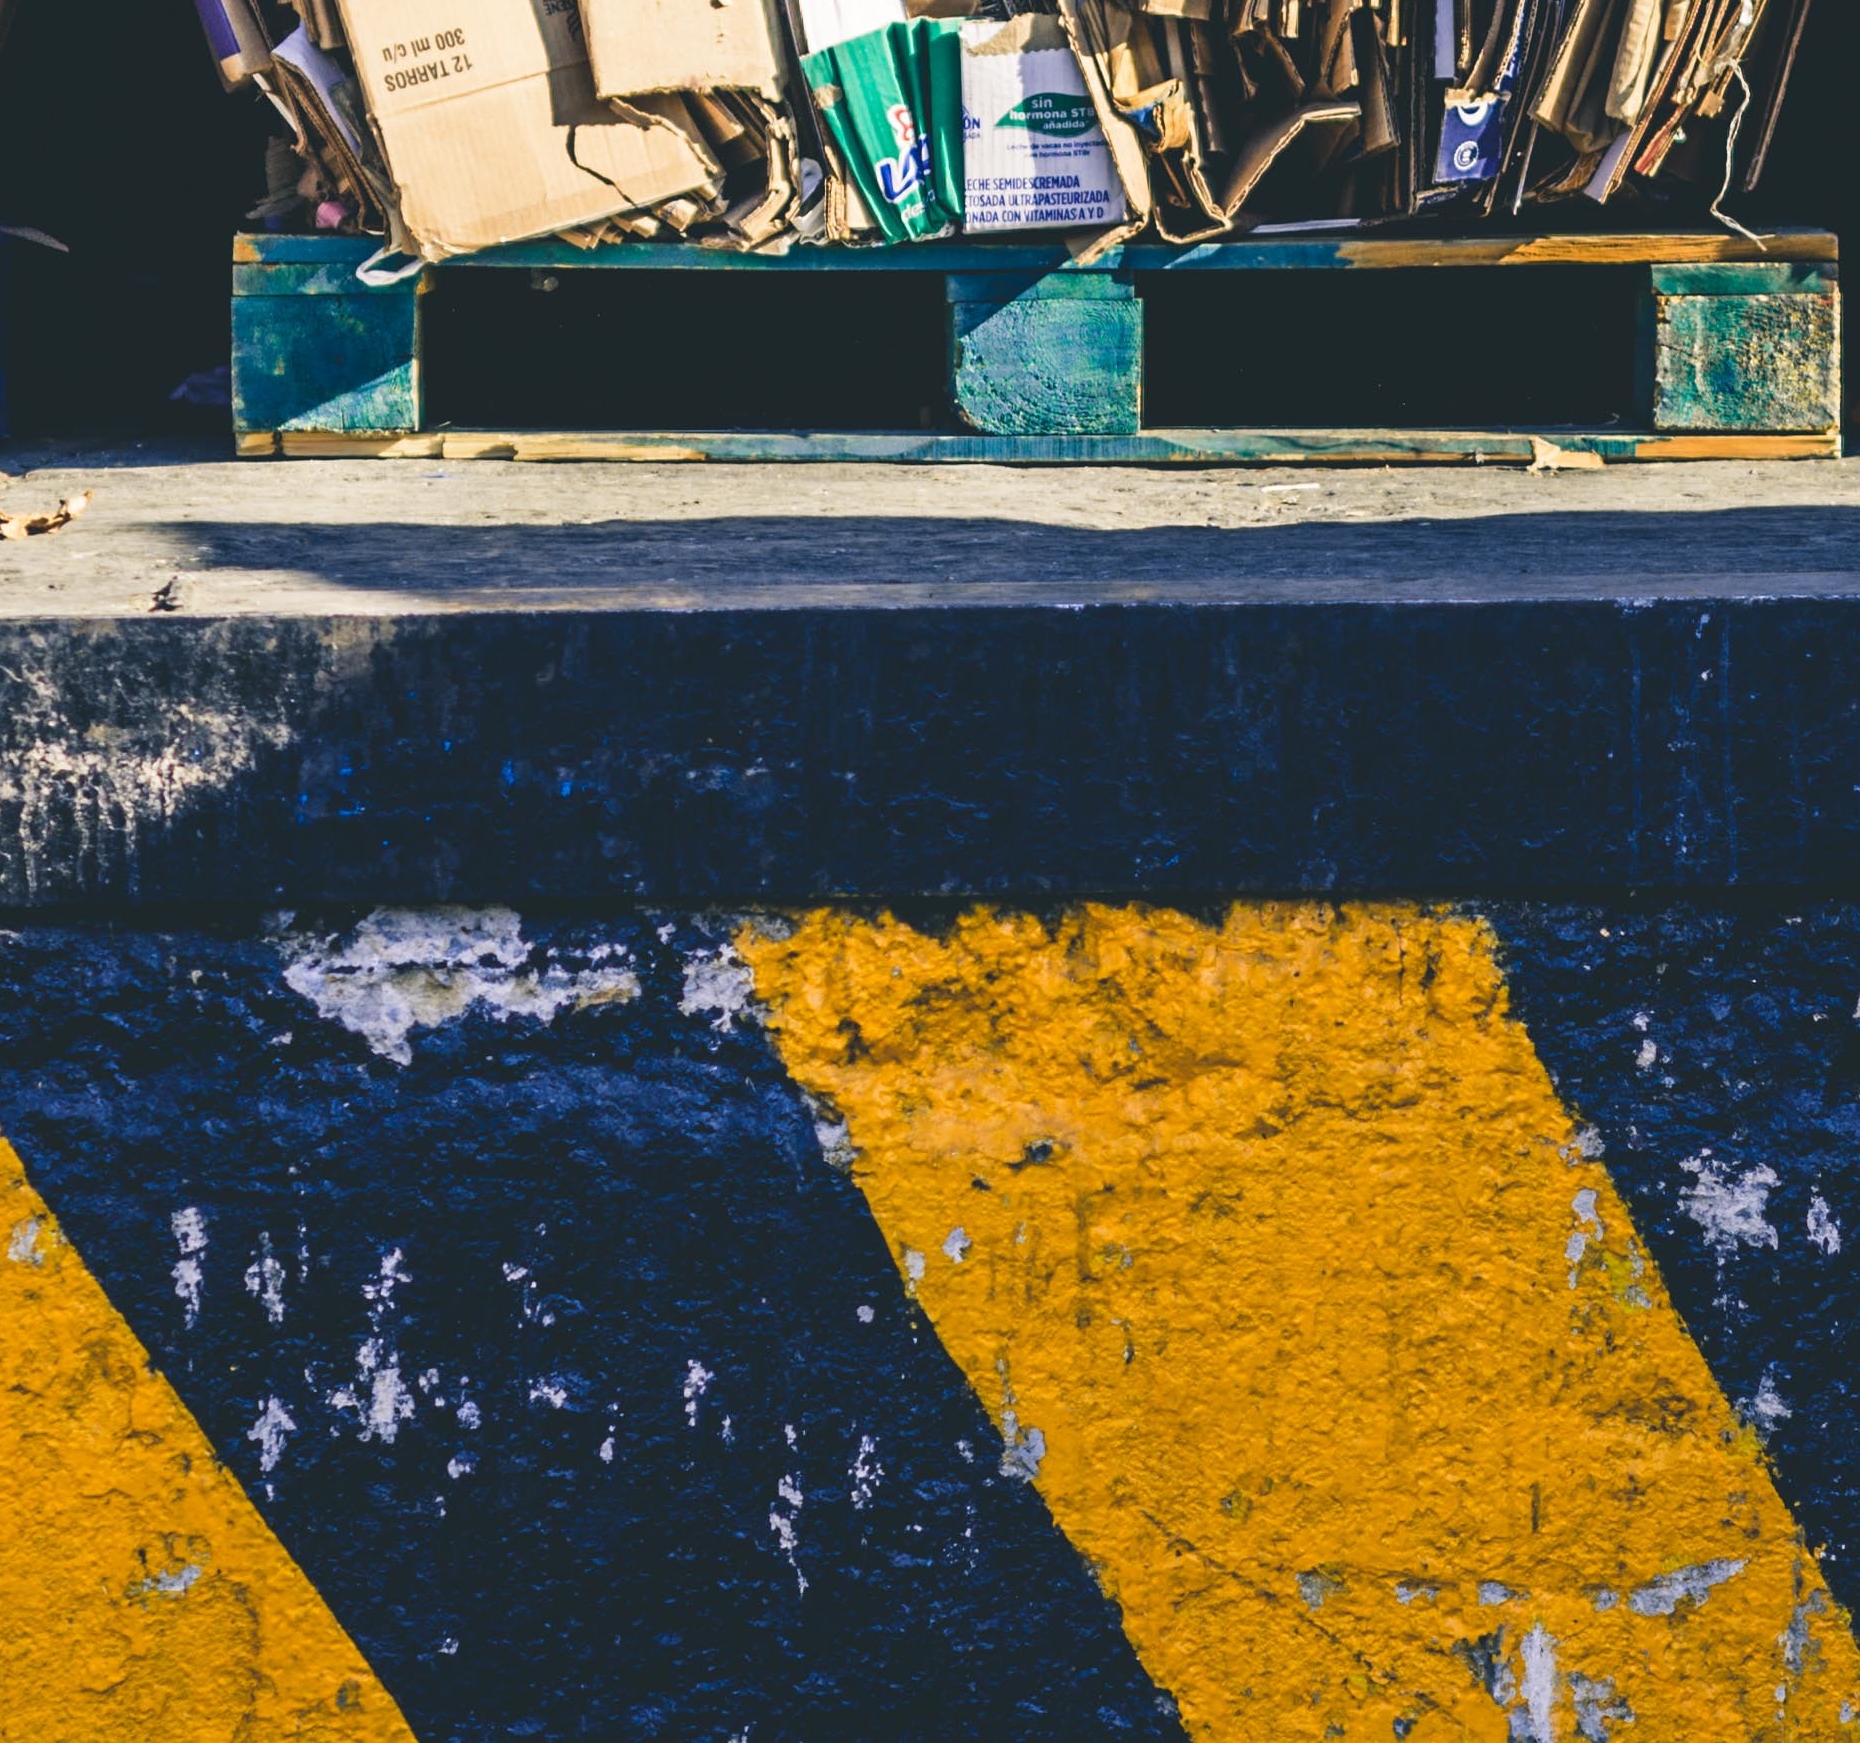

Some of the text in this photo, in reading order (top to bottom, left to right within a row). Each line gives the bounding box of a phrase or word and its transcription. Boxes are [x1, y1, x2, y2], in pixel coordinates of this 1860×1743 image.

[381, 27, 467, 64] 300 ml c/u
[384, 54, 474, 94] 12 TARROS
[1031, 96, 1053, 108] sin
[1009, 107, 1068, 121] hormona
[1043, 120, 1086, 130] añadida
[1041, 142, 1062, 150] vacas
[992, 175, 1081, 191] SEMIDESCREMADA
[1008, 190, 1110, 207] ULTRAPASTEURIZADA
[1002, 210, 1021, 222] CON
[1024, 208, 1077, 221] VITAMINAS
[1077, 208, 1086, 219] A
[1085, 207, 1095, 218] Y
[1097, 206, 1105, 218] D
